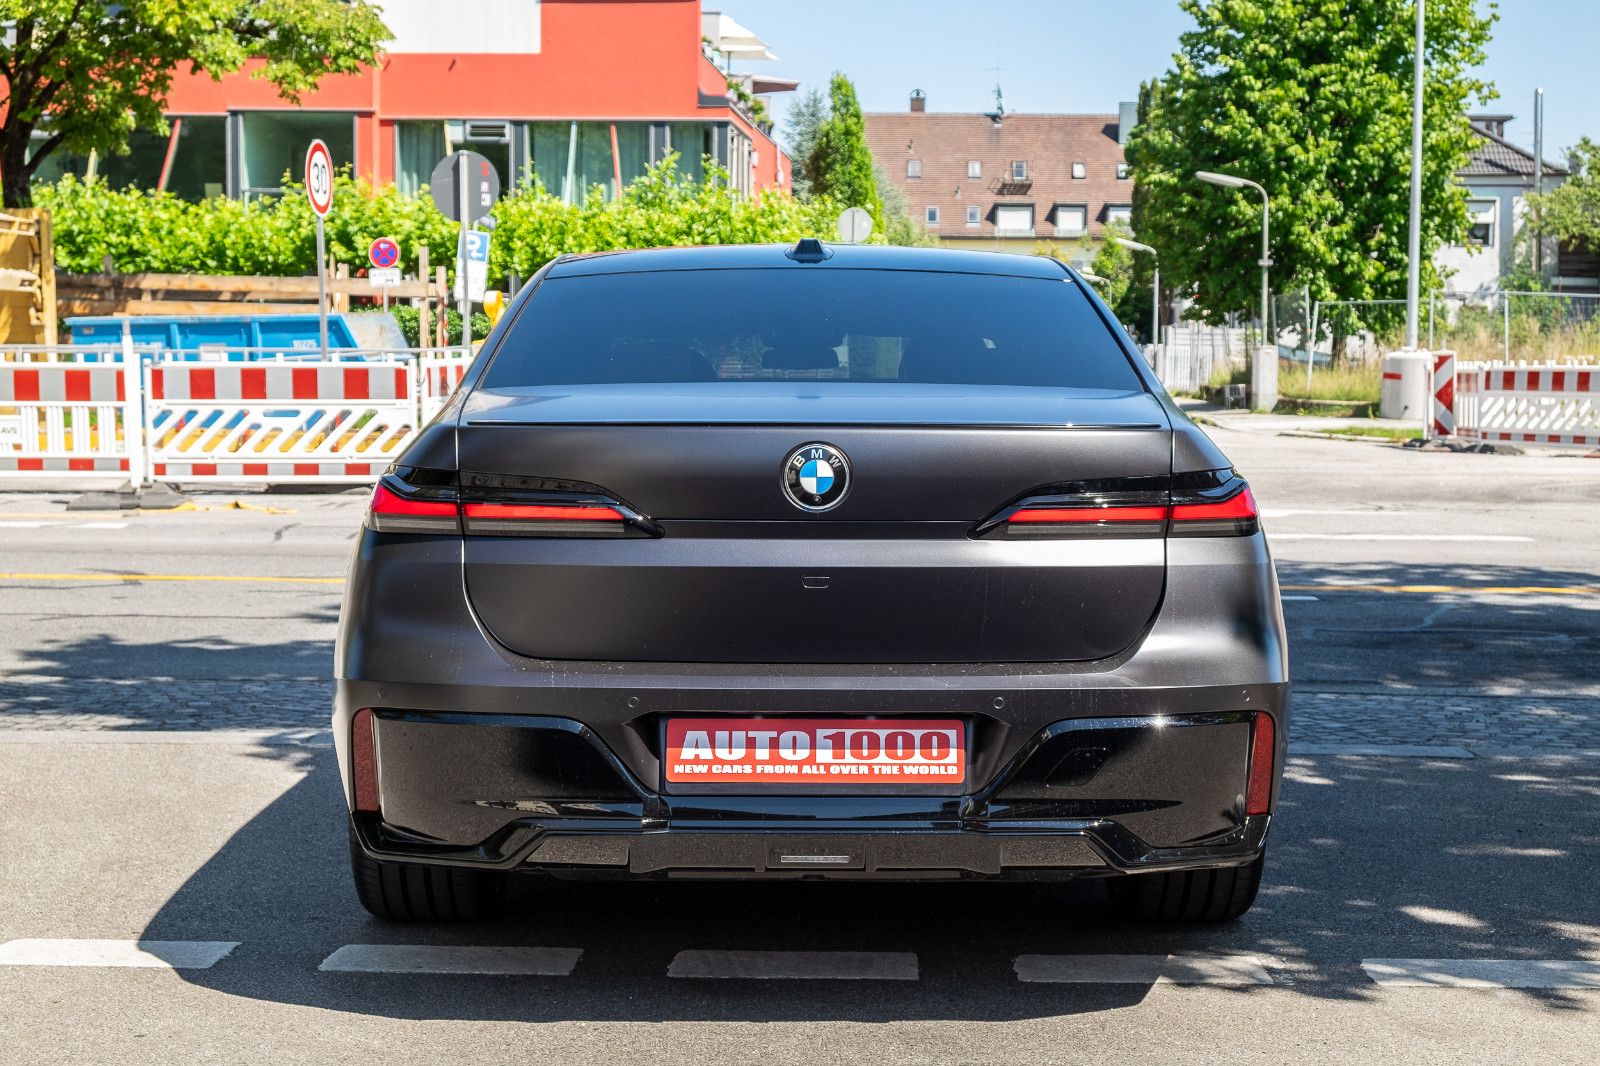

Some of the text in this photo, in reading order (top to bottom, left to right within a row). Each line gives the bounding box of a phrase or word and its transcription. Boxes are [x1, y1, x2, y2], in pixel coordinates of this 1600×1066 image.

[313, 162, 327, 194] 30
[793, 448, 842, 468] BMW
[680, 730, 951, 761] AUTO 1000
[674, 764, 958, 775] NEW CARS FROM ALL OVER THE WORLD
